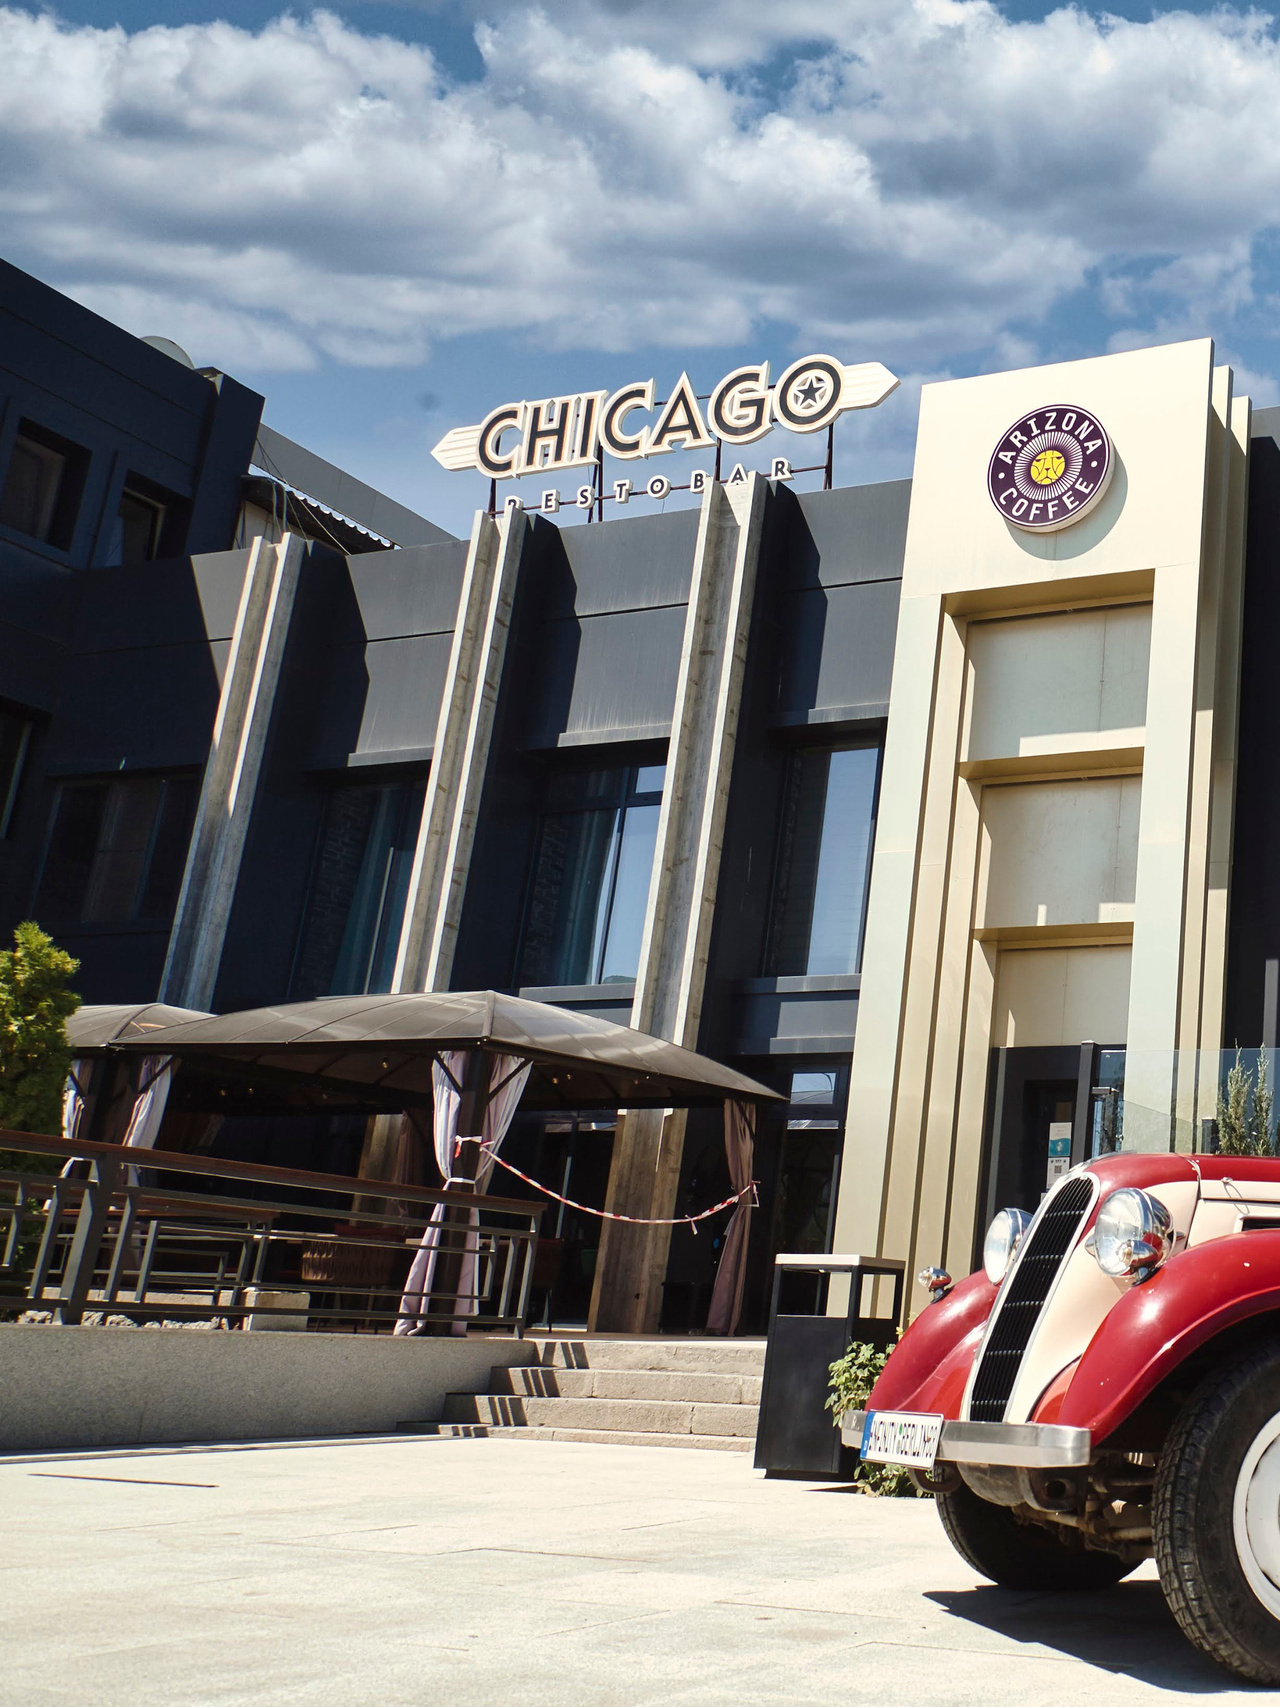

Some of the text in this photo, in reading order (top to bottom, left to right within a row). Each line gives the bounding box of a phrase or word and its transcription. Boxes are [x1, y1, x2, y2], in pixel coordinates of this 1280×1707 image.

[474, 356, 846, 477] CHICAGO
[998, 411, 1103, 465] ARIZONA
[999, 477, 1094, 521] COFFEE
